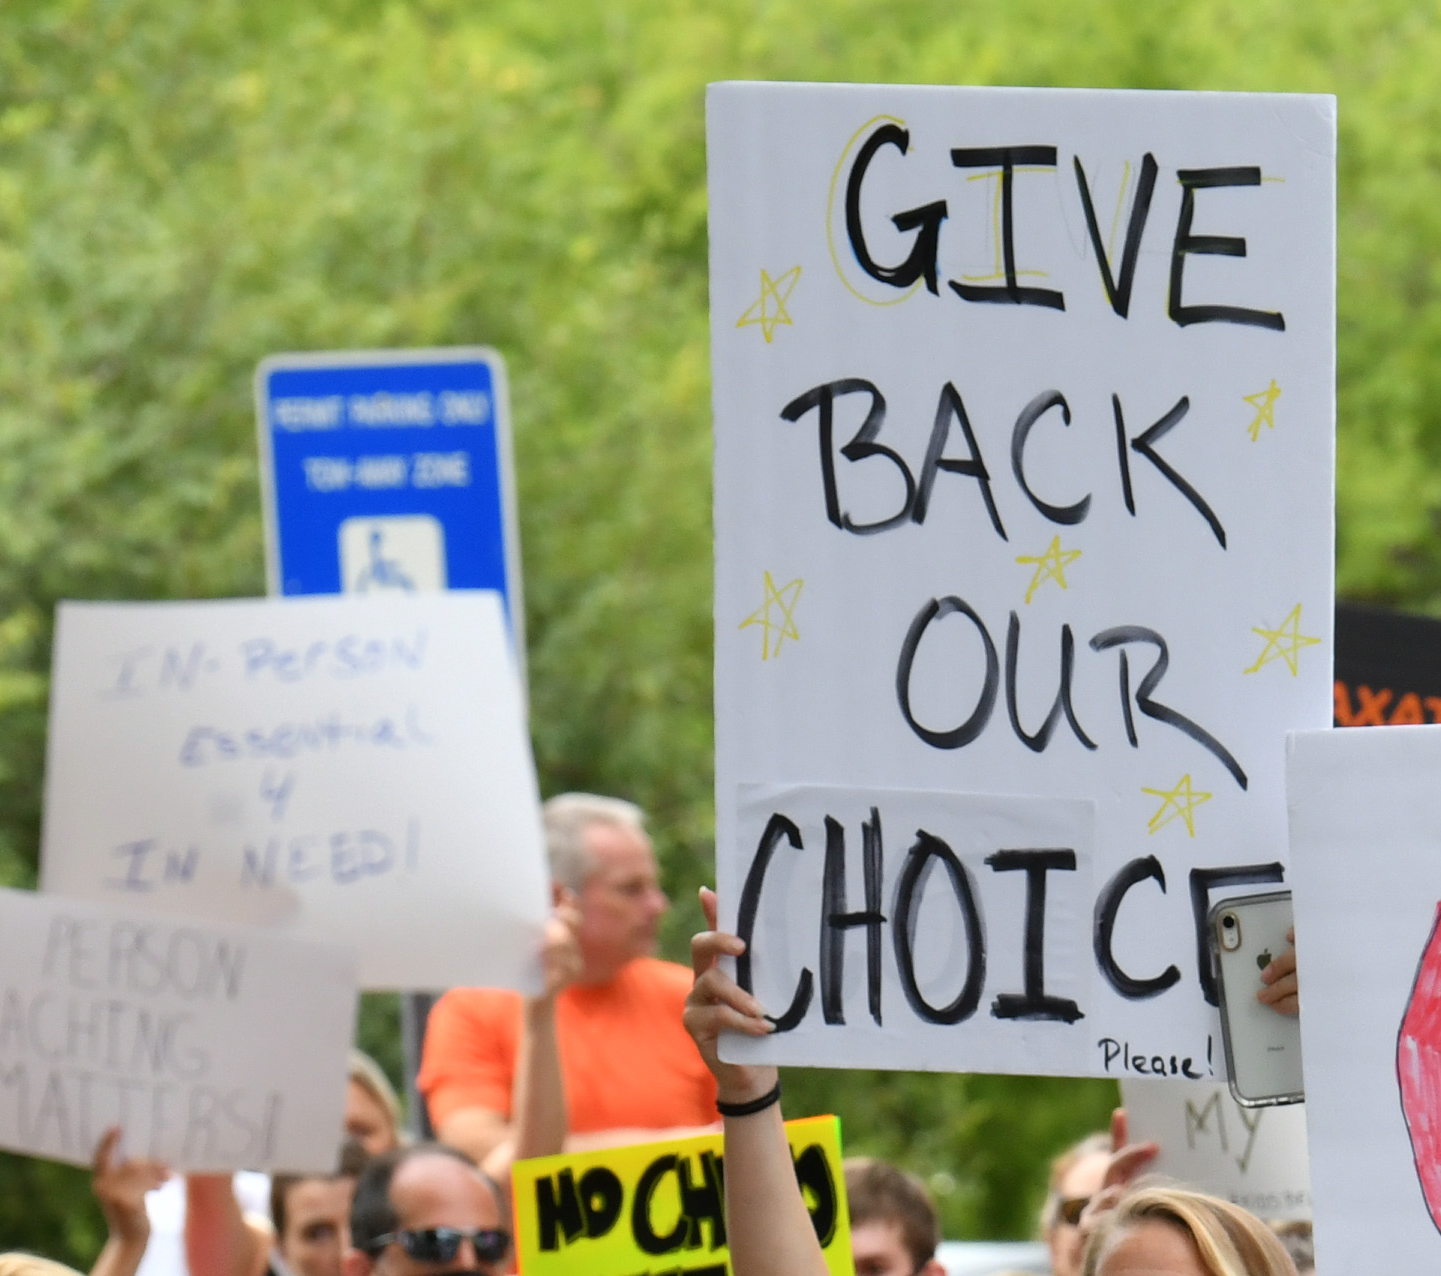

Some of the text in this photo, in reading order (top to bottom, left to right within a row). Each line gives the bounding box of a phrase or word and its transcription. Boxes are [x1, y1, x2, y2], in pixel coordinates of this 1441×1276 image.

[844, 122, 1286, 332] GIVE
[779, 377, 1227, 551] BACK
[895, 595, 1248, 791] OUR
[1097, 1034, 1214, 1079] Please!
[534, 1166, 624, 1254] NO
